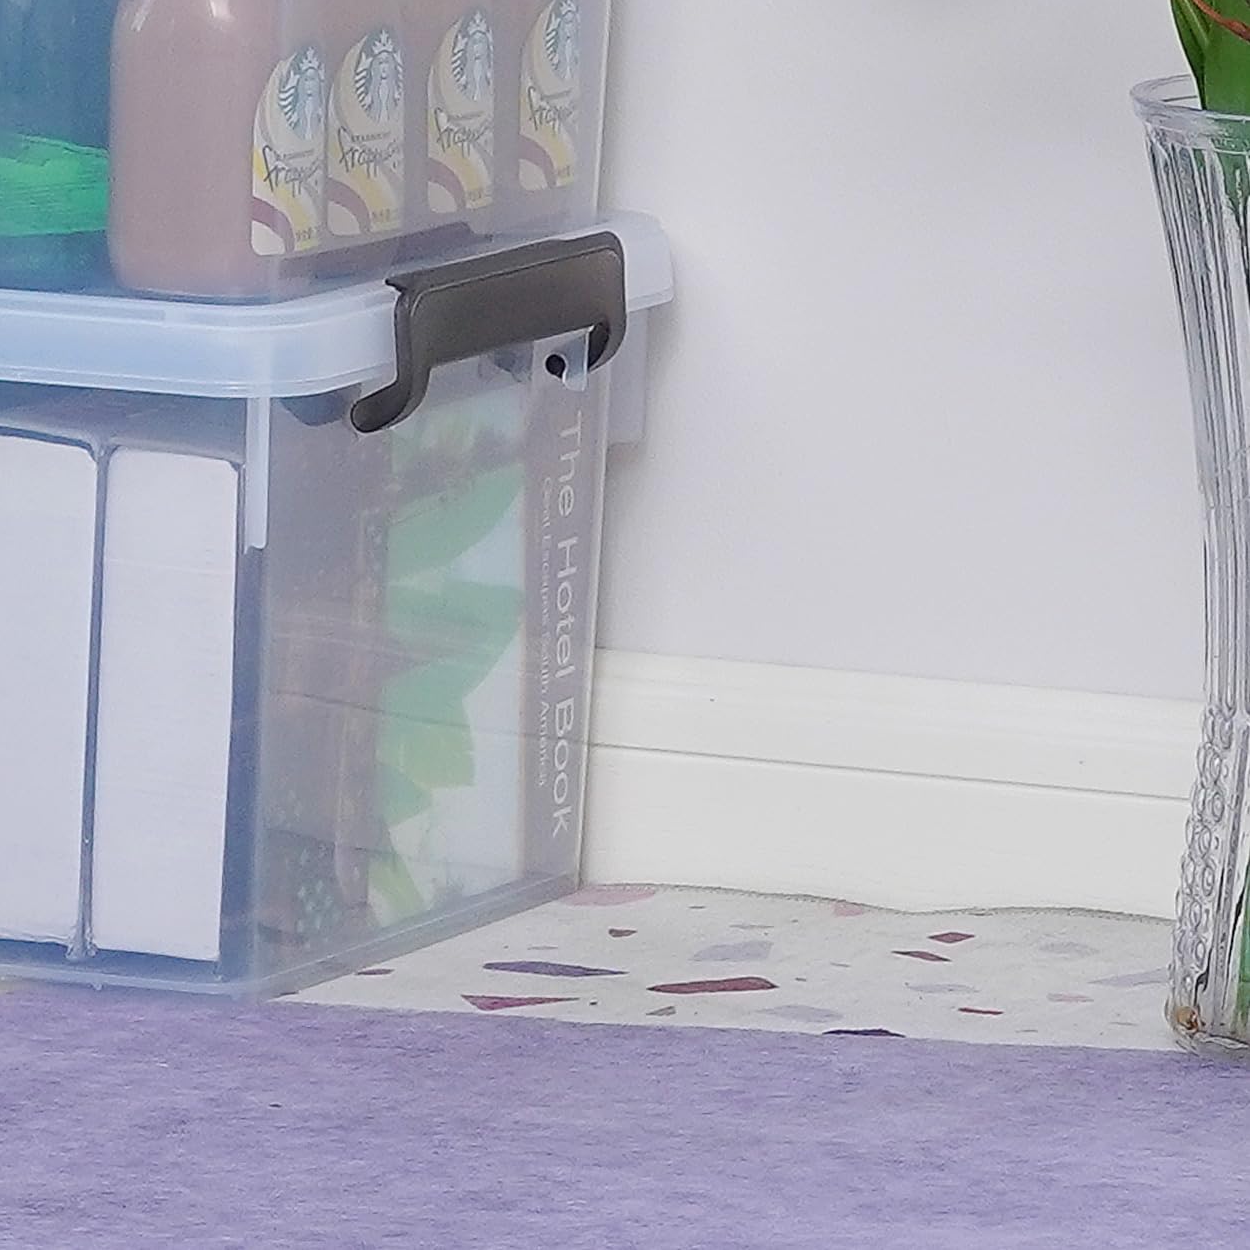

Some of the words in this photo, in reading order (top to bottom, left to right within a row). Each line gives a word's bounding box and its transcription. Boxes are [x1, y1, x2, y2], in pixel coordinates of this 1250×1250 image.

[557, 410, 583, 518] The
[554, 536, 579, 678] Hotel
[551, 697, 575, 838] Book
